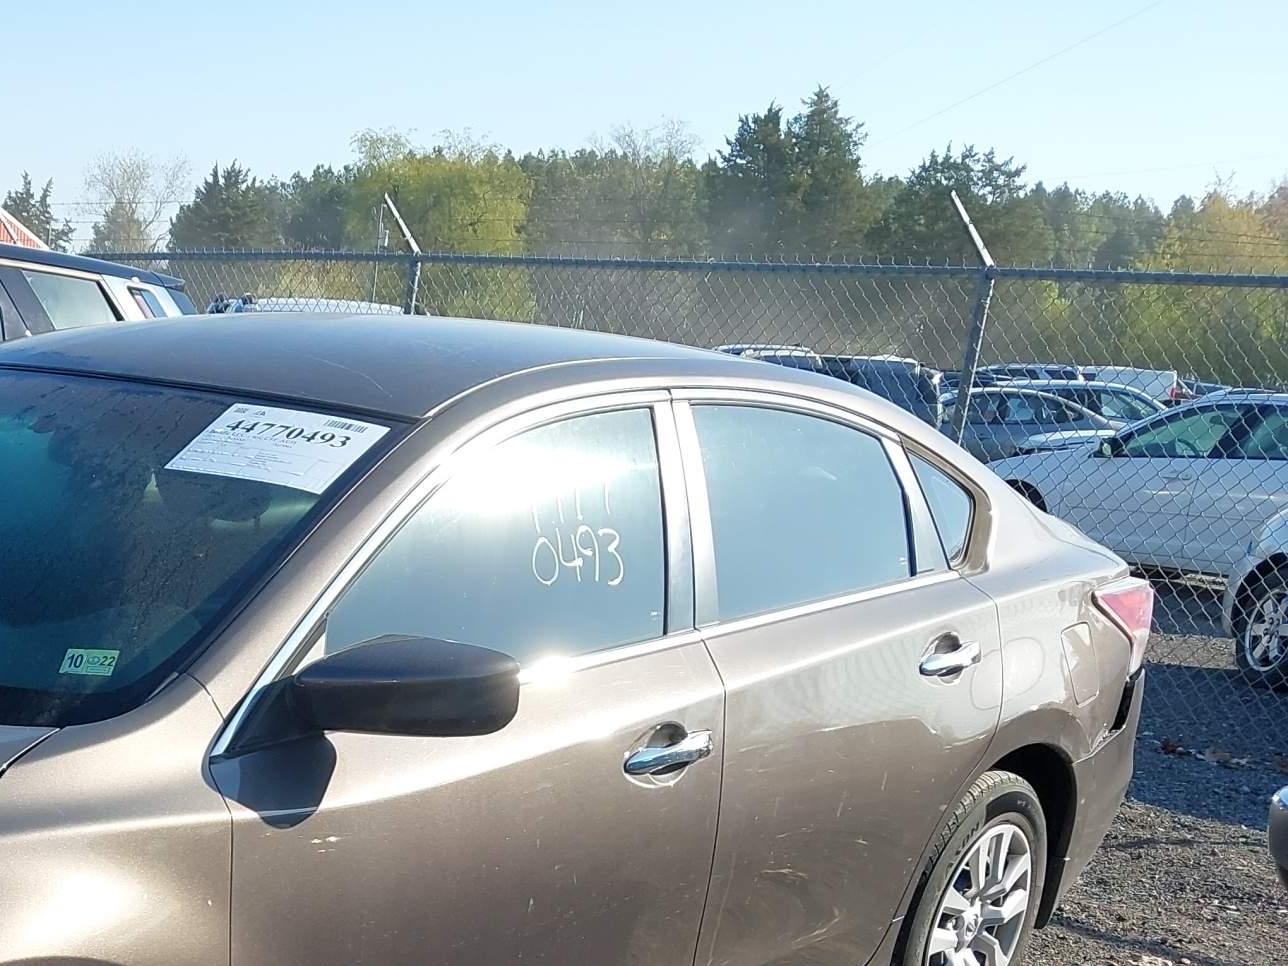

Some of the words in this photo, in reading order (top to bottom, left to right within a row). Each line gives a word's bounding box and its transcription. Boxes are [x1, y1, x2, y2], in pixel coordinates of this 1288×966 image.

[226, 418, 352, 449] 44770493
[531, 524, 625, 586] 0493
[67, 653, 84, 669] 10
[99, 655, 116, 667] 22
